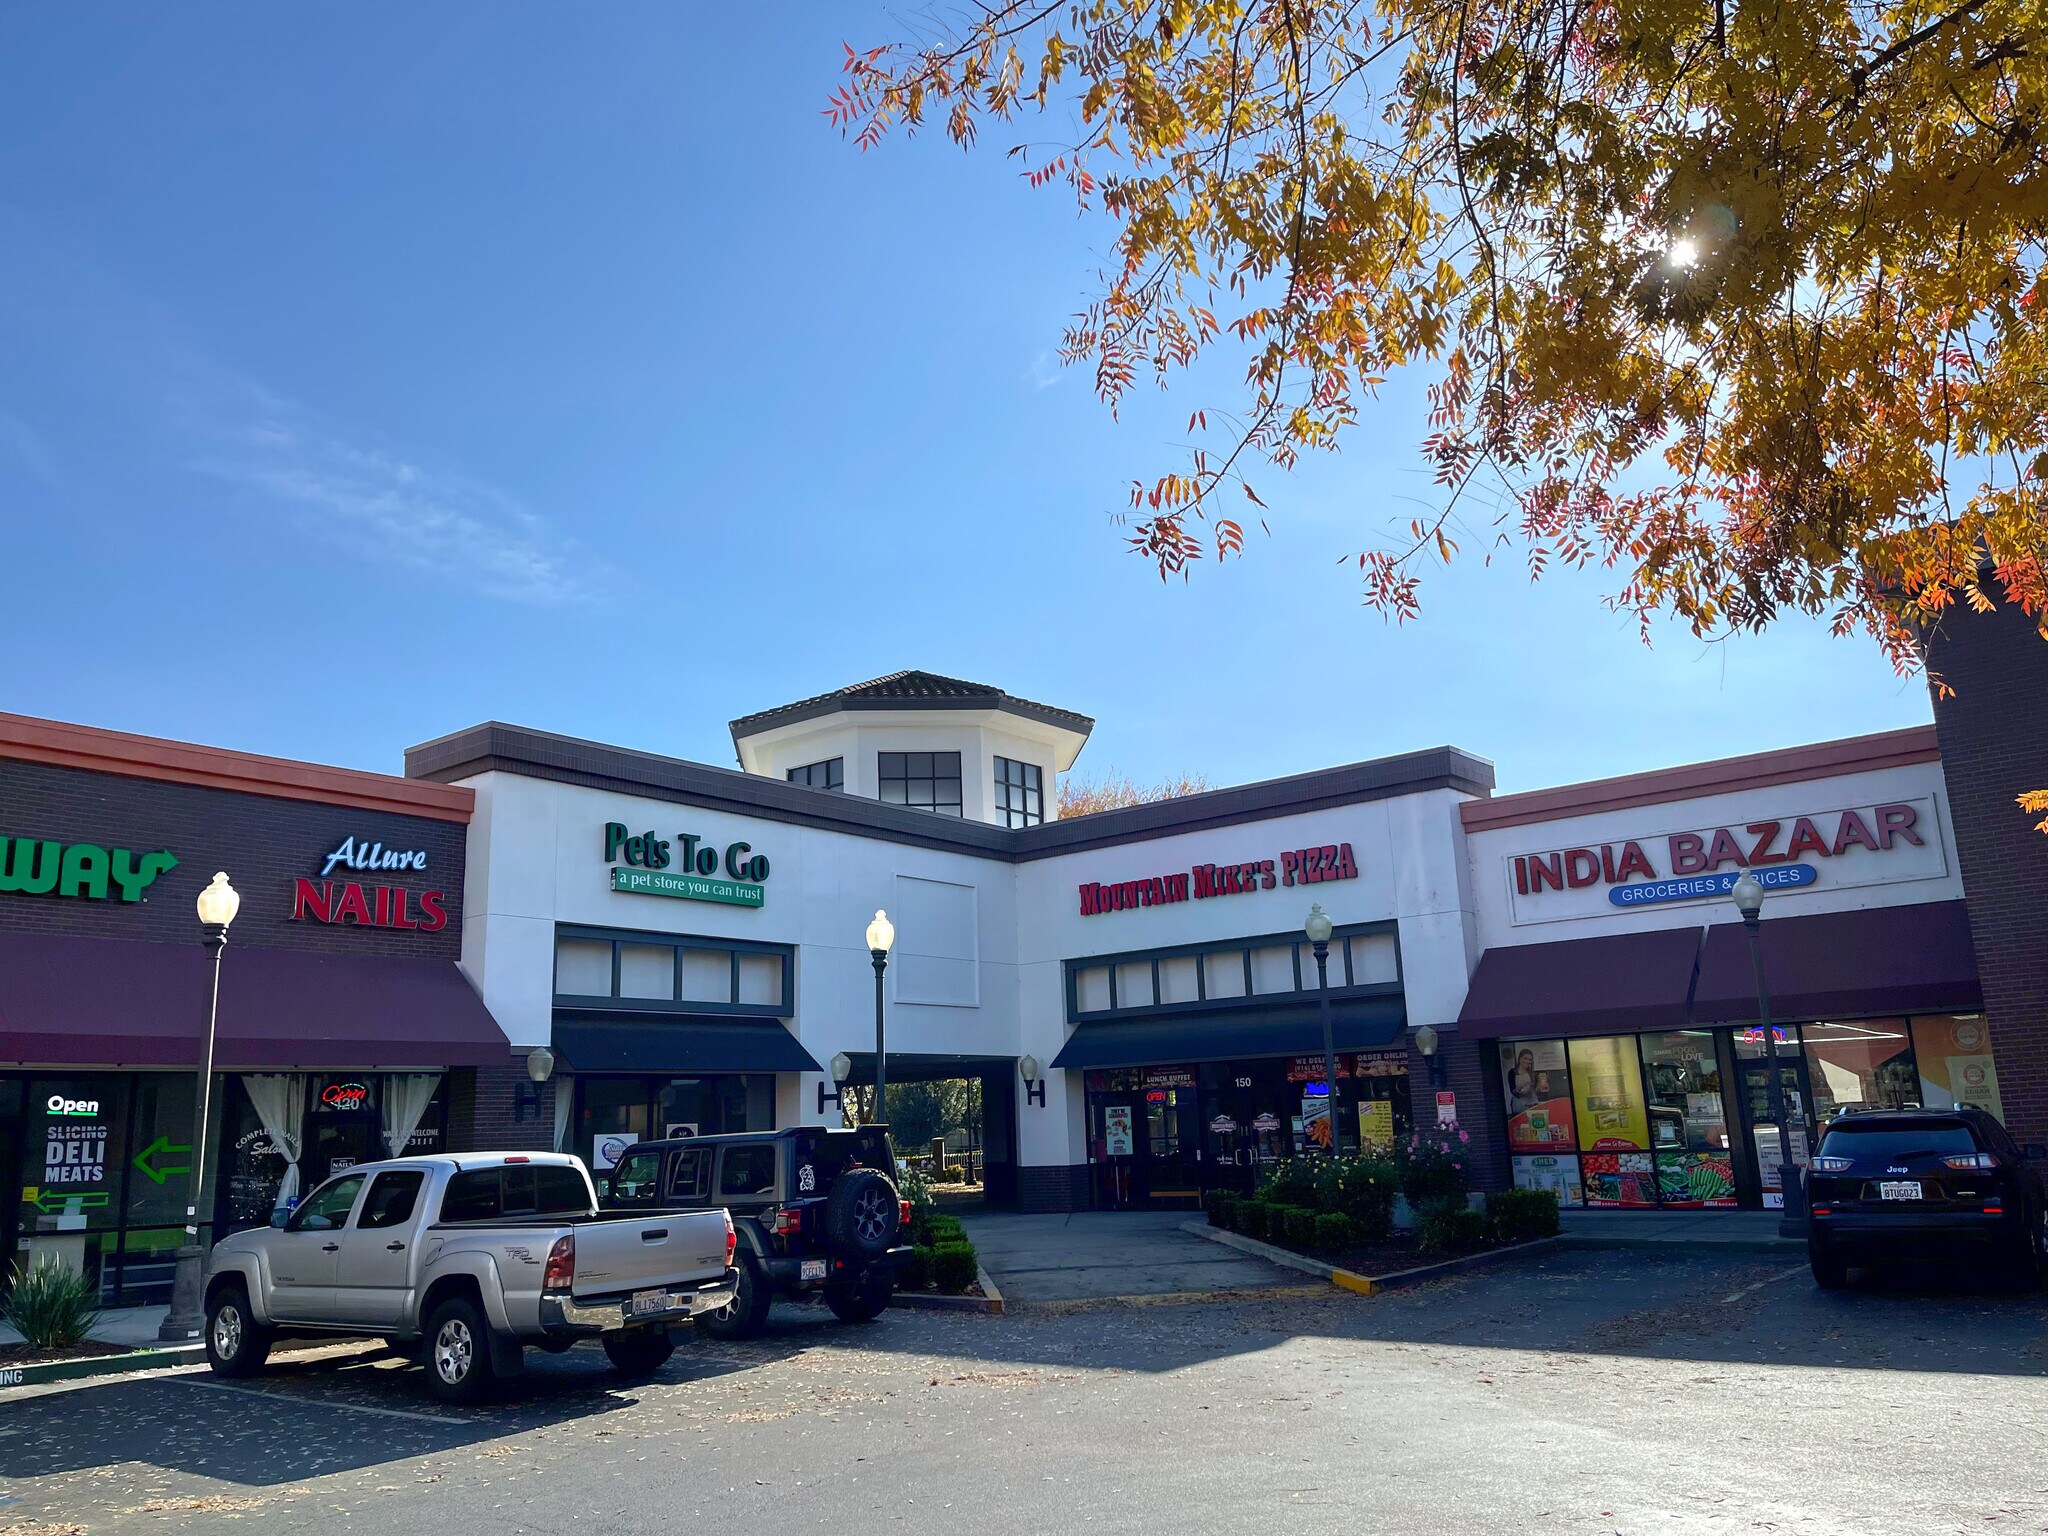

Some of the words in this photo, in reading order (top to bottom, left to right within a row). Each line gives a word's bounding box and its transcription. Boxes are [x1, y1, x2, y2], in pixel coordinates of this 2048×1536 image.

[320, 836, 427, 876] Allure
[604, 821, 671, 869] Pets
[677, 833, 718, 876] To
[725, 841, 770, 882] Go
[1515, 842, 1656, 895] INDIA
[1669, 804, 1925, 875] BAZAAR
[619, 872, 627, 883] a
[631, 874, 651, 889] pet
[654, 875, 685, 891] store
[688, 883, 709, 896] you
[712, 885, 732, 896] can
[735, 886, 761, 900] trust
[1079, 873, 1190, 916] MOUNTAIN
[1192, 859, 1276, 899] MIKE'S
[1281, 843, 1358, 887] PIZZA
[1621, 879, 1716, 901] GROCERIES
[1721, 877, 1732, 889] &
[1746, 869, 1801, 888] ICES
[288, 878, 448, 932] NAILS
[1743, 1029, 1783, 1044] OPN
[1357, 1053, 1382, 1061] ORDER
[1383, 1052, 1408, 1060] ONLIN
[1672, 1046, 1697, 1054] FOOD
[1681, 1052, 1704, 1061] LOVE
[1308, 1056, 1339, 1064] DELIR
[1146, 1075, 1168, 1083] LUNCH
[1168, 1074, 1191, 1082] BUFFET
[1234, 1077, 1252, 1087] 150
[1146, 1091, 1166, 1102] OPEN
[47, 1095, 99, 1115] Open
[47, 1125, 108, 1139] SLICING
[45, 1141, 105, 1165] DELI
[1534, 1157, 1553, 1166] SHER
[44, 1165, 103, 1183] MEATS
[1886, 1165, 1909, 1174] Jeep
[1884, 1188, 1919, 1198] 8TUG023
